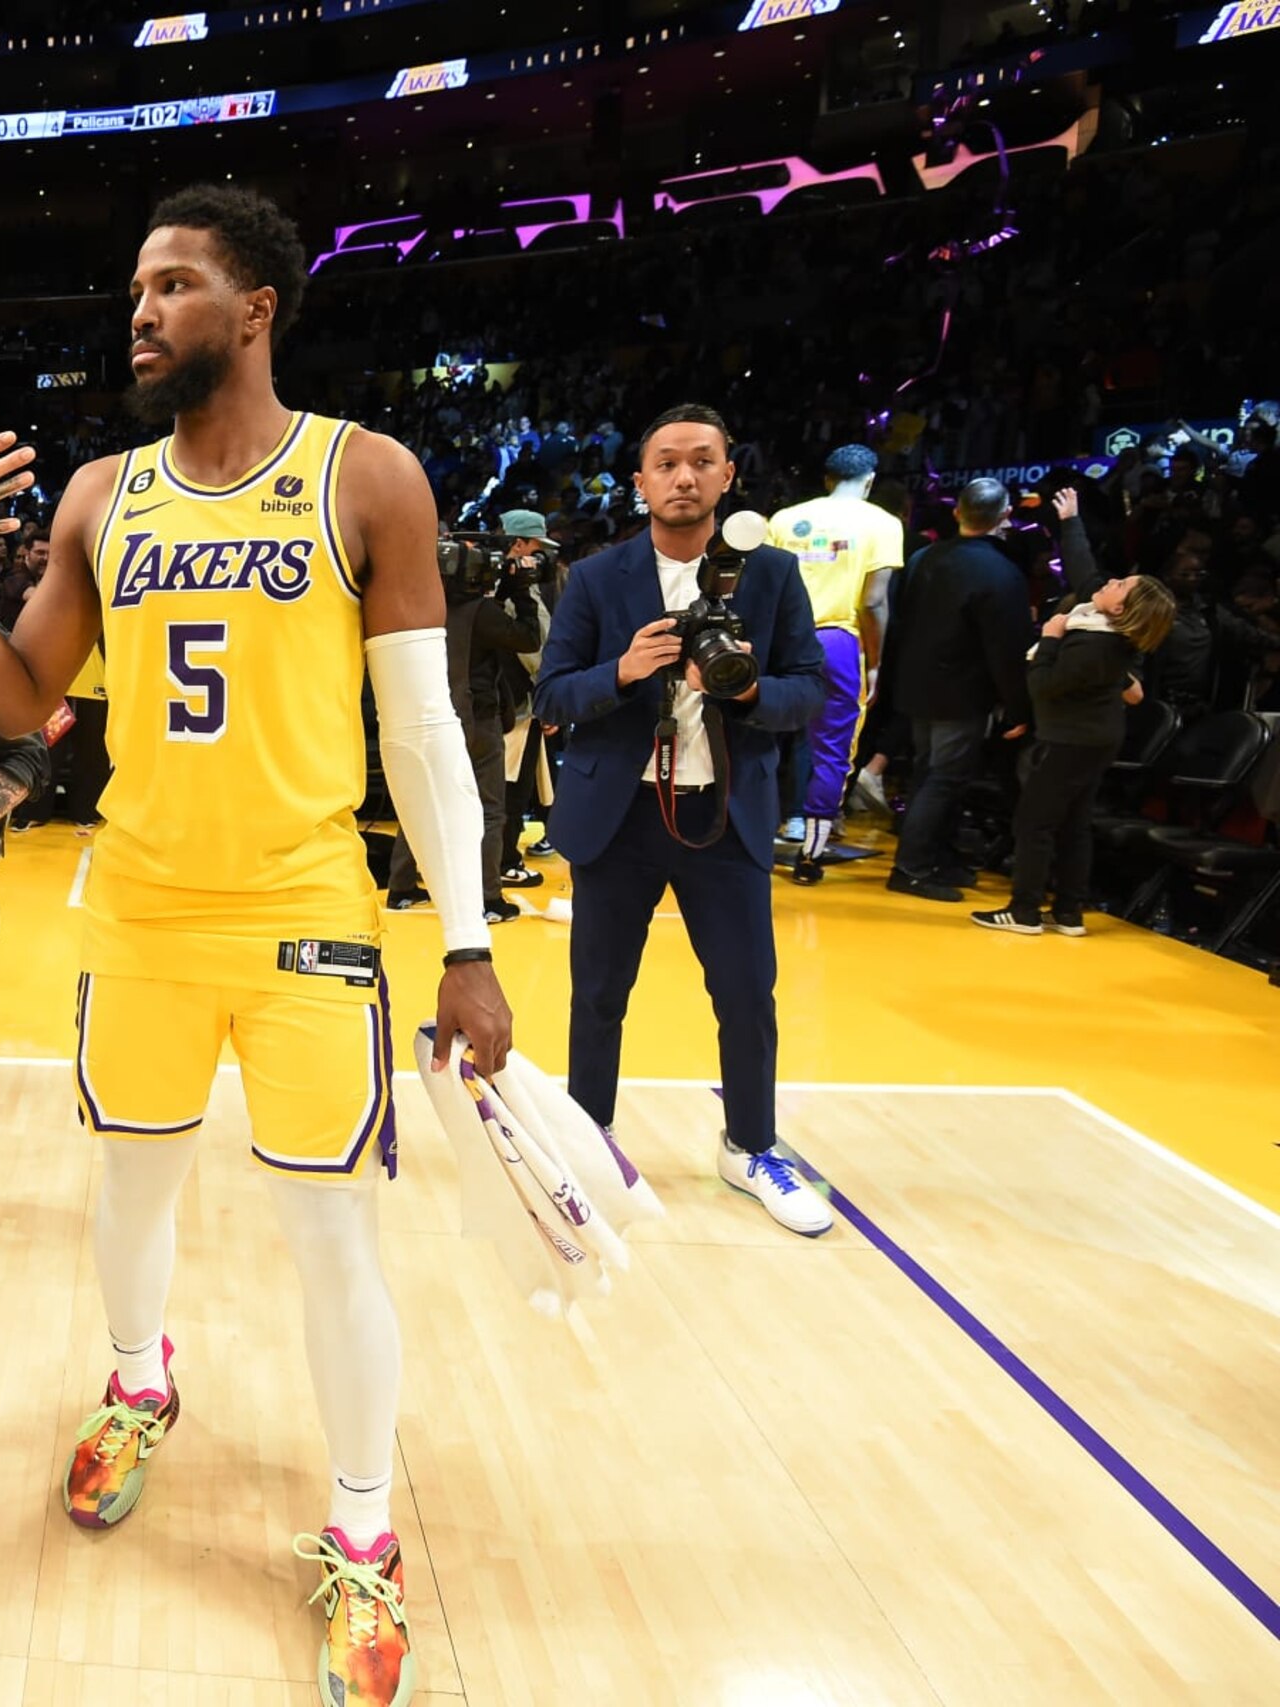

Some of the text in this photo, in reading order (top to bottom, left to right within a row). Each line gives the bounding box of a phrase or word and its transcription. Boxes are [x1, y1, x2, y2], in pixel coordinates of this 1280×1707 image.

[72, 115, 125, 130] Pelicans
[139, 105, 177, 125] 102
[50, 121, 59, 134] 4
[132, 471, 151, 492] 6
[261, 499, 314, 516] bibigo
[111, 533, 314, 609] LAKERS
[165, 620, 228, 744] 5
[660, 744, 671, 780] Canon
